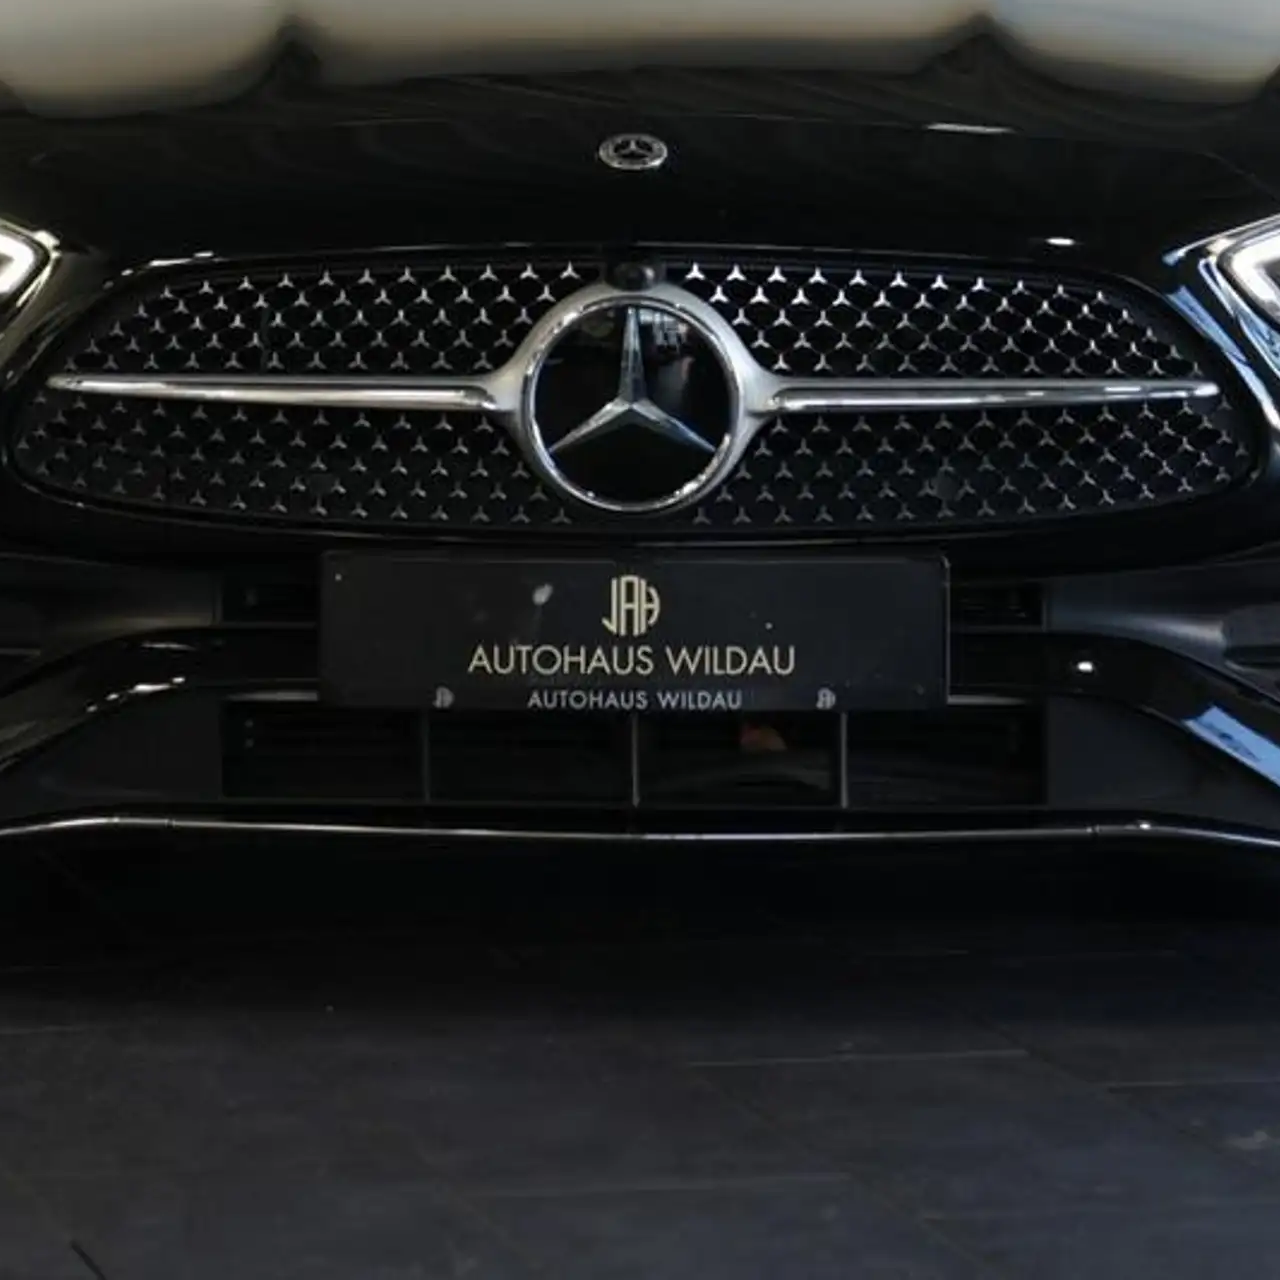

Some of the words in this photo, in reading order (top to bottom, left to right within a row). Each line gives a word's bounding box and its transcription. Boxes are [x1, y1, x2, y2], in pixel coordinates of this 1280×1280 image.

[467, 643, 655, 677] AUTOHAUS
[664, 644, 796, 677] WILDAU
[527, 689, 649, 711] AUTOHAUS
[656, 689, 742, 711] WILDAU
